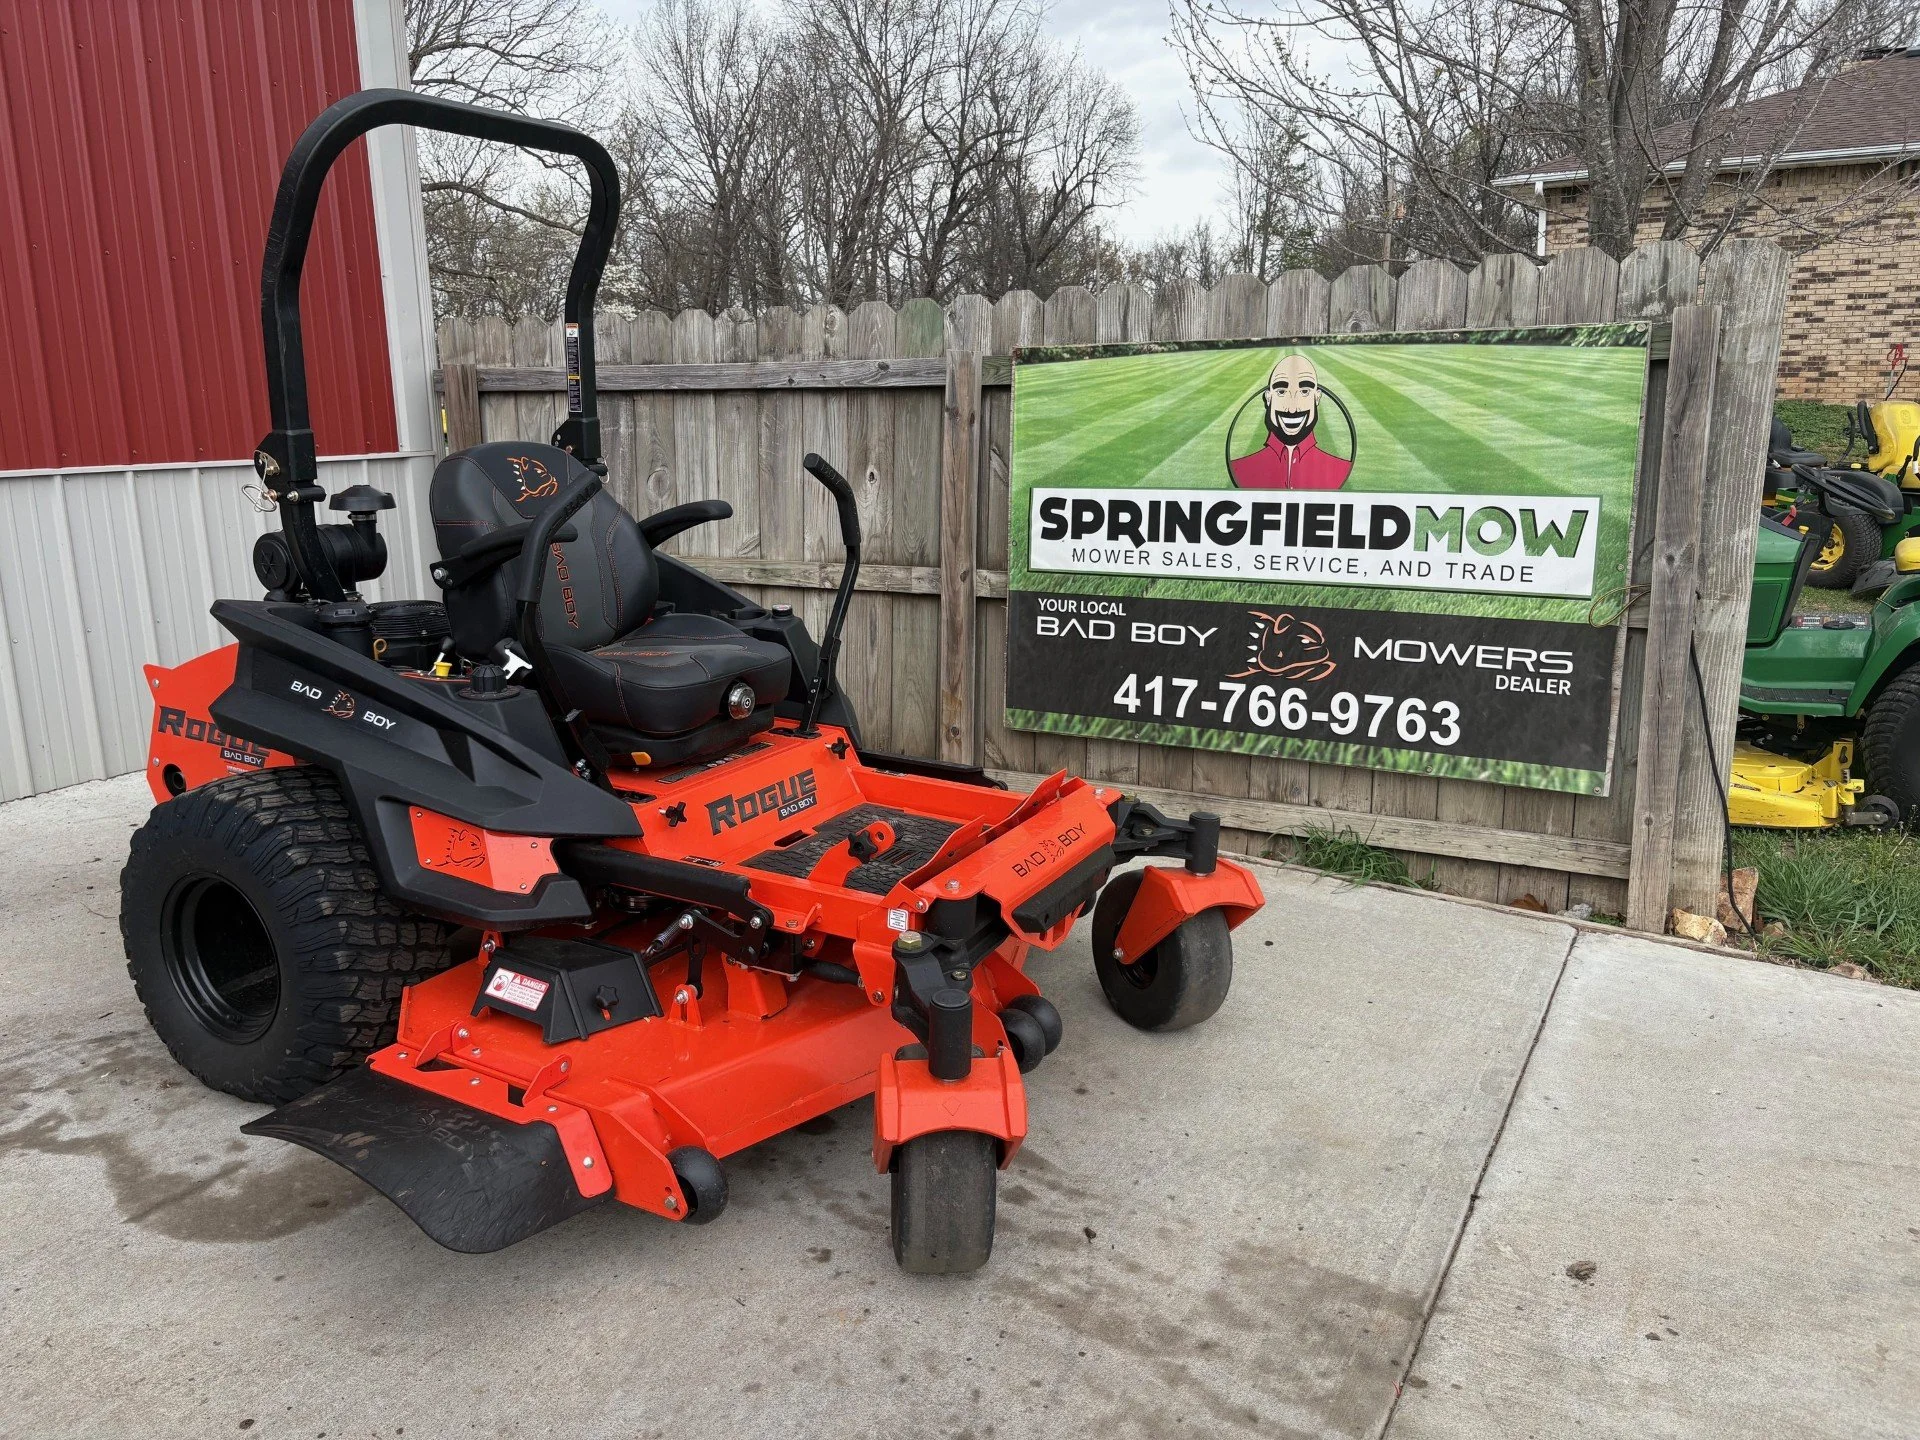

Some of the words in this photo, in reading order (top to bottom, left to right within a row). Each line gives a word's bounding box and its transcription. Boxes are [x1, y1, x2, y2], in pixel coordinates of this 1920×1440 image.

[1039, 497, 1589, 559] SPRINGFIELDMOW
[1072, 548, 1150, 565] MOWER
[1162, 551, 1241, 571] SALES,
[1253, 555, 1368, 577] SERVICE,
[1380, 560, 1432, 578] AND
[1446, 562, 1534, 583] TRADE
[551, 542, 569, 581] BAD
[562, 587, 579, 629] BOY
[1038, 598, 1076, 613] YOUR
[1080, 600, 1127, 616] LOCAL
[1036, 616, 1116, 640] BAD
[1130, 622, 1219, 647] BOY
[1353, 636, 1574, 674] MOWERS
[1495, 674, 1572, 695] DEALER
[290, 680, 322, 700] BAD
[363, 710, 396, 730] BOY
[1113, 673, 1461, 746] 417-766-9763
[224, 749, 242, 761] BAD
[244, 755, 262, 765] BOY
[704, 768, 817, 836] ROGUE
[780, 804, 798, 817] BAD
[798, 796, 814, 809] BOY
[1012, 850, 1047, 878] BAD
[1057, 823, 1087, 848] BOY
[521, 978, 547, 992] DANGER
